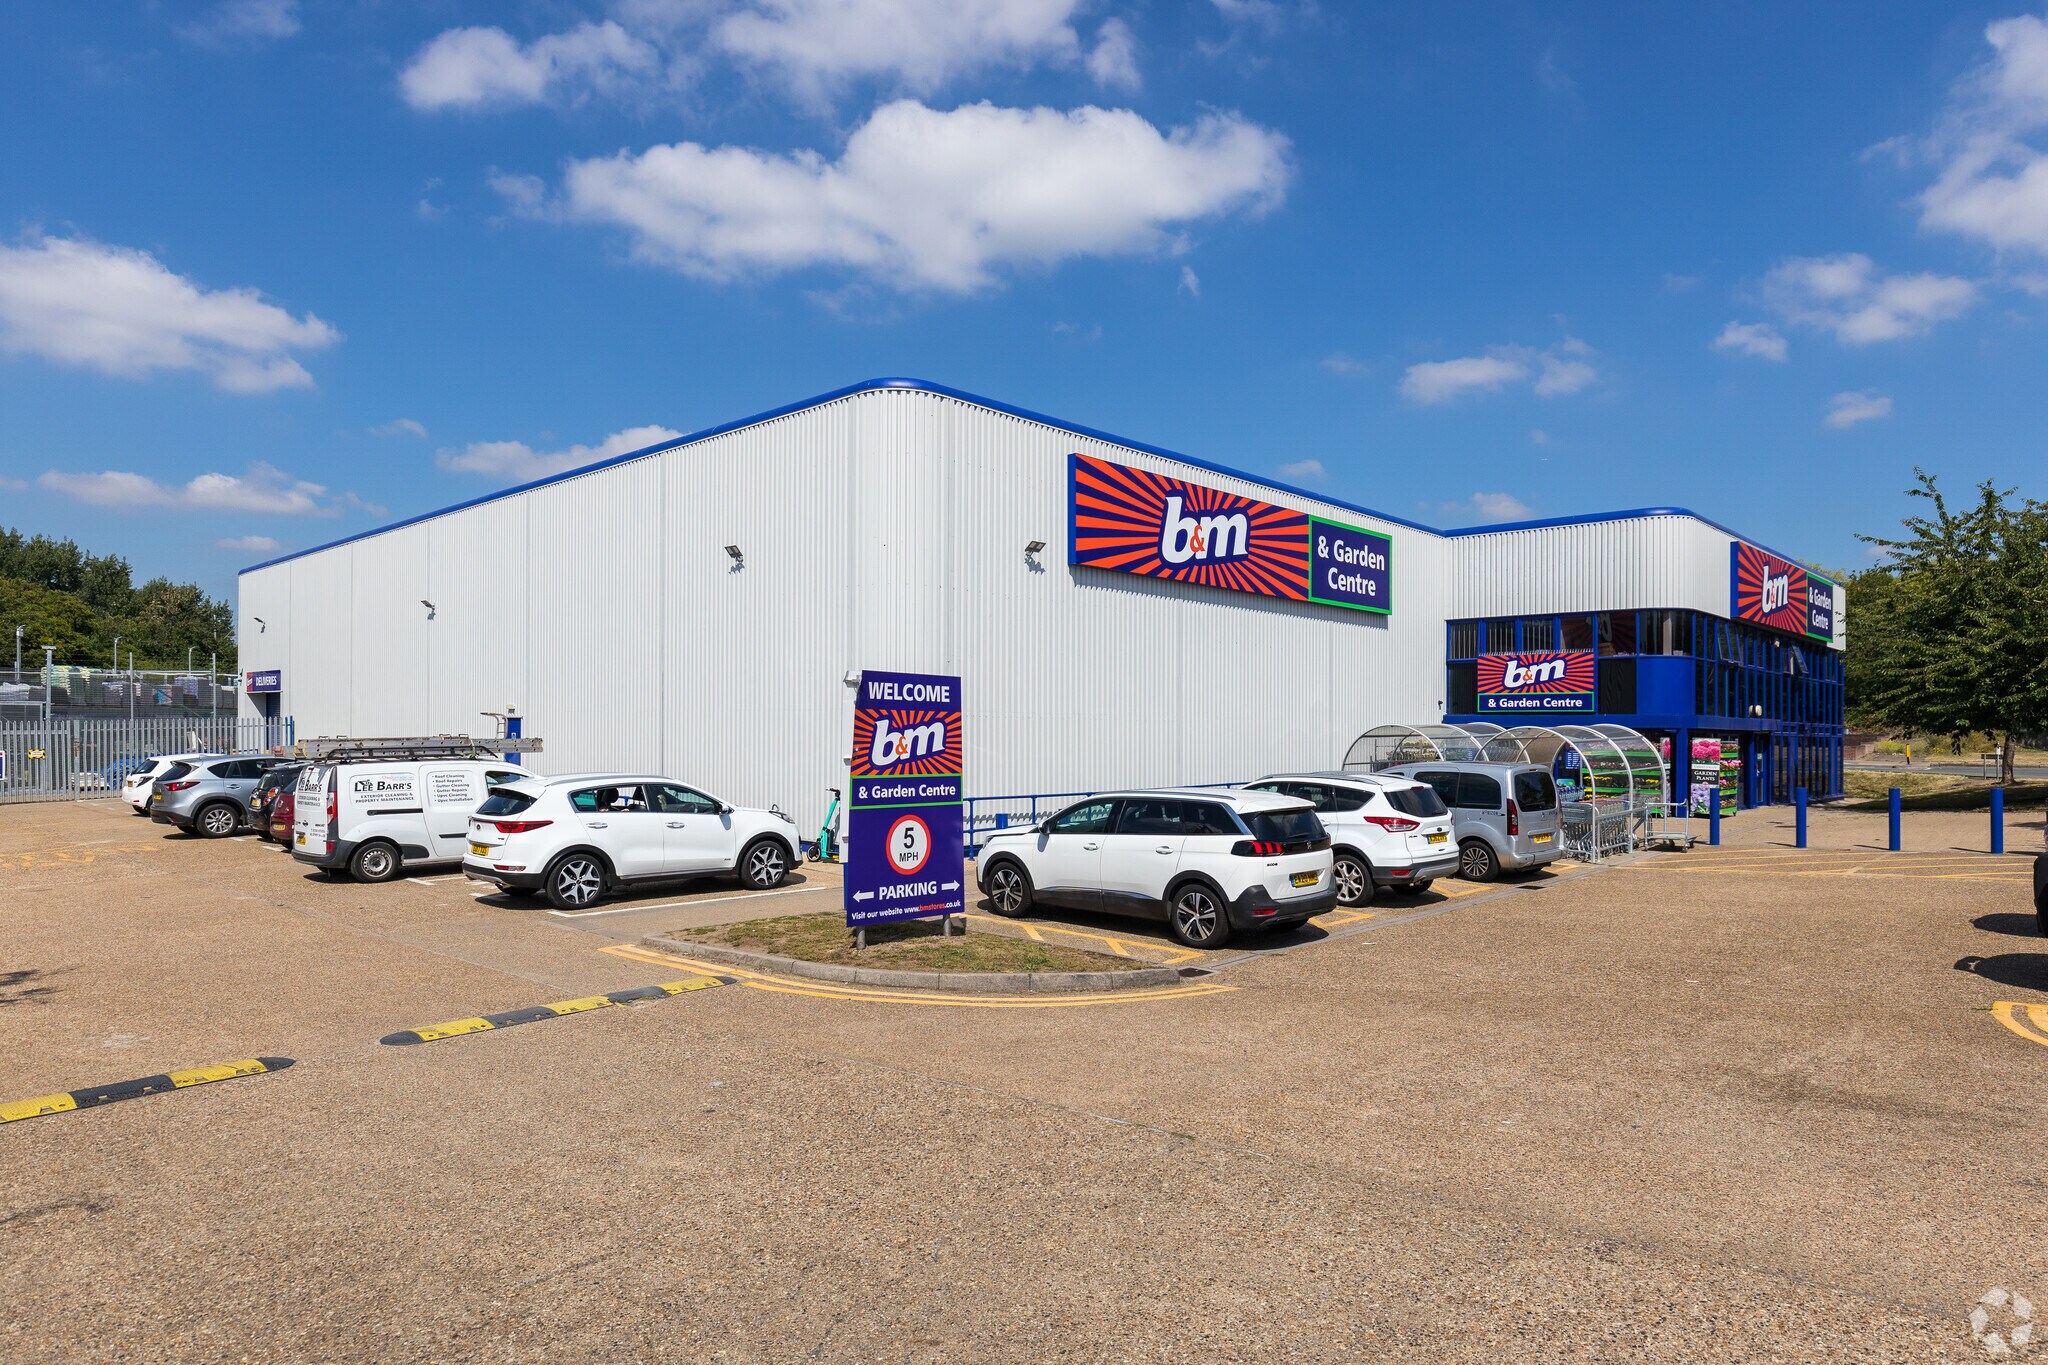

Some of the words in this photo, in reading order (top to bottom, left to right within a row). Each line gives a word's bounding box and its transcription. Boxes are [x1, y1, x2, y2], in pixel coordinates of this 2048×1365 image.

[1161, 496, 1249, 564] b&m
[1317, 534, 1330, 559] &
[1333, 539, 1385, 571] Garden
[1328, 567, 1377, 597] Centre
[1762, 565, 1788, 613] b&m
[1809, 586, 1814, 604] &
[1814, 588, 1832, 610] Garden
[1812, 609, 1828, 630] Centre
[255, 675, 277, 687] DELIVERIES
[1504, 659, 1565, 688] b&m
[868, 681, 950, 703] WELCOME
[1488, 698, 1497, 708] &
[1499, 697, 1540, 707] Garden
[1543, 697, 1583, 707] Centre
[872, 719, 946, 766] b&m
[354, 779, 374, 792] LEE
[376, 780, 412, 791] BARR'S
[858, 786, 868, 799] &
[871, 784, 916, 798] Garden
[918, 784, 956, 796] Centre
[903, 826, 915, 850] 5
[899, 851, 919, 862] MPH
[879, 880, 937, 901] PARKING
[851, 911, 866, 920] Visit
[879, 907, 903, 917] website
[904, 899, 961, 914] www.bmstores.co.uk
